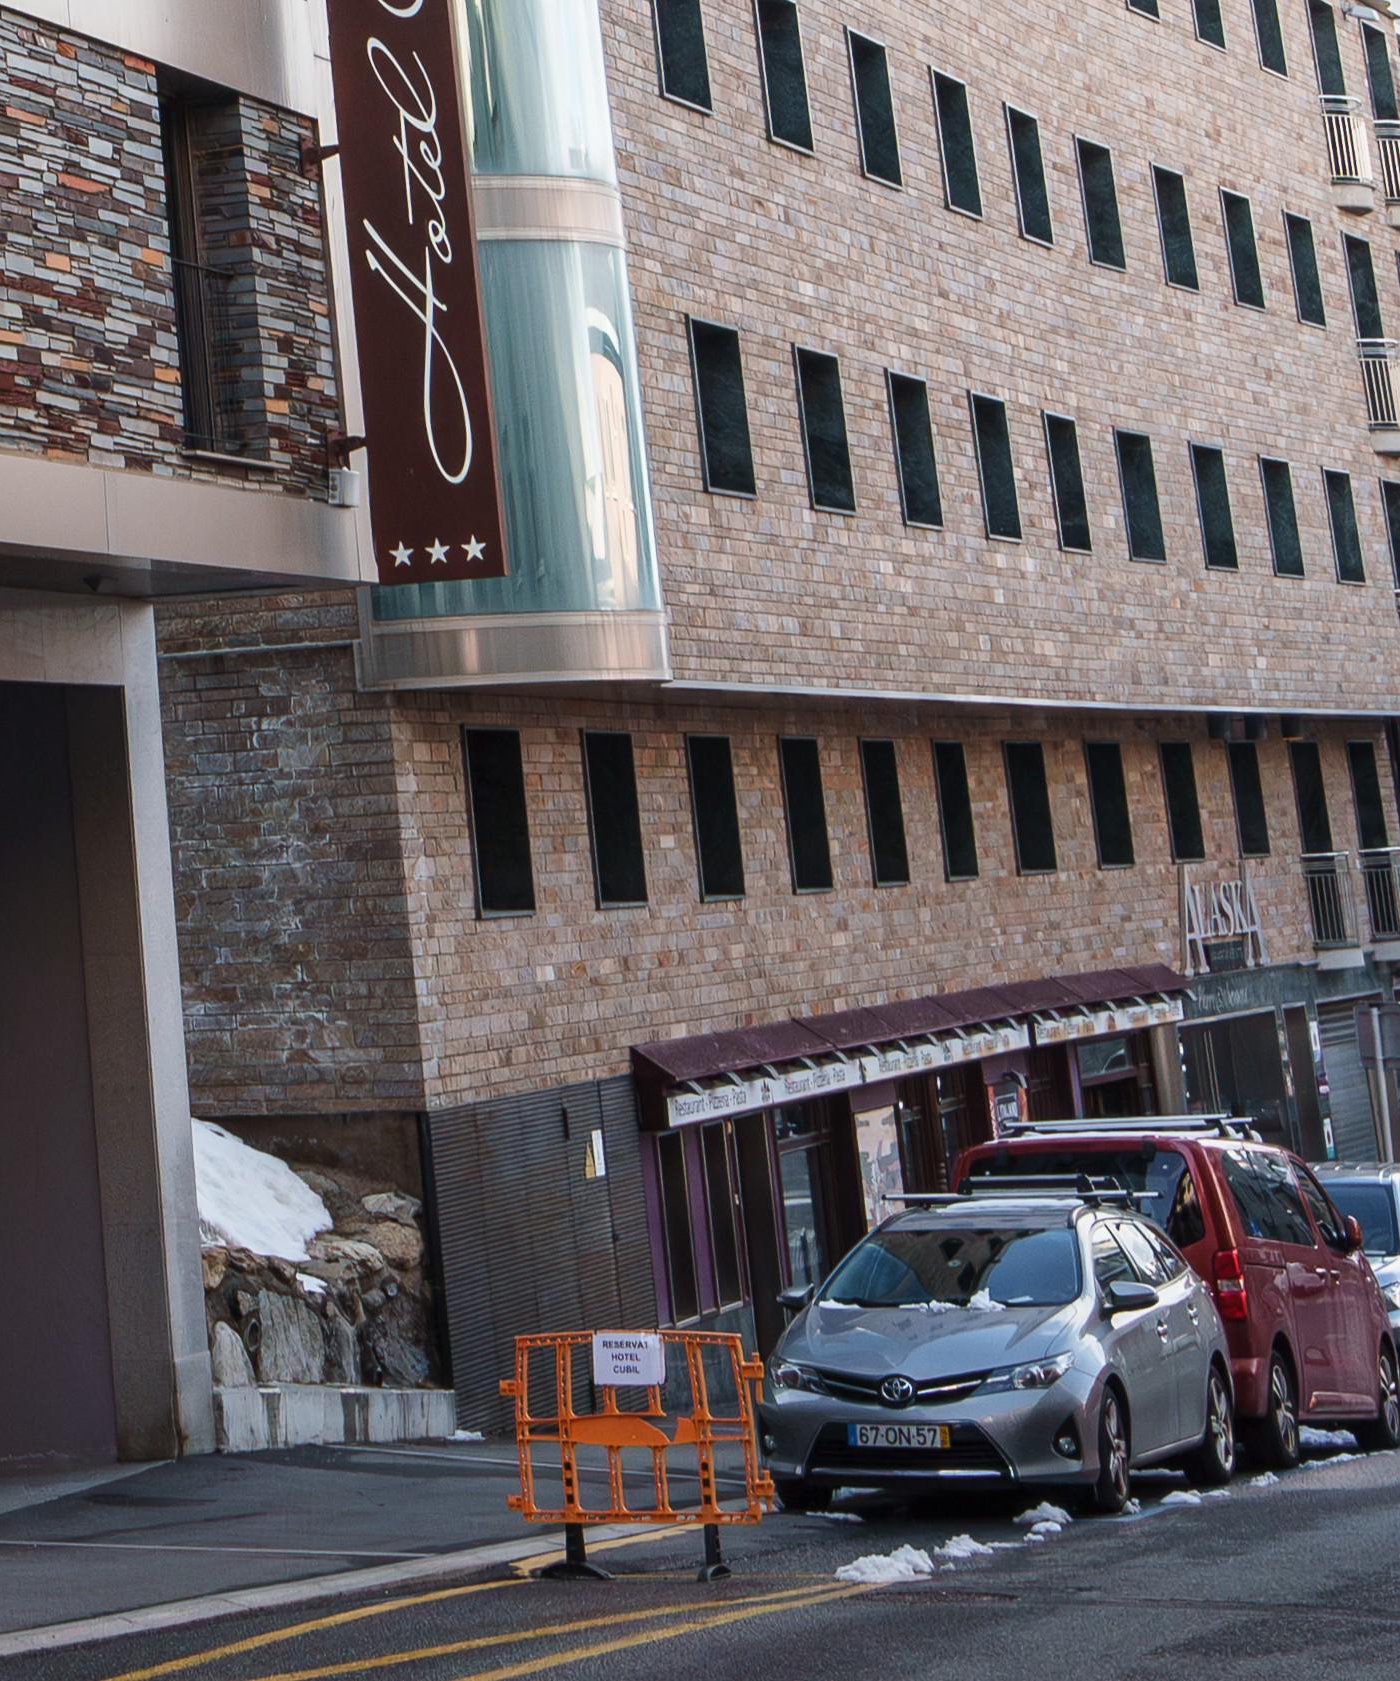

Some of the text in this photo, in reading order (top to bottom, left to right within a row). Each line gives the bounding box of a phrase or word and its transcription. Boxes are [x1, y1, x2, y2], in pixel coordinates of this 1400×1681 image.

[362, 36, 473, 484] Hotel
[1184, 864, 1271, 976] ALASKA
[611, 1352, 641, 1362] HOTEL
[613, 1365, 640, 1374] CUBIL
